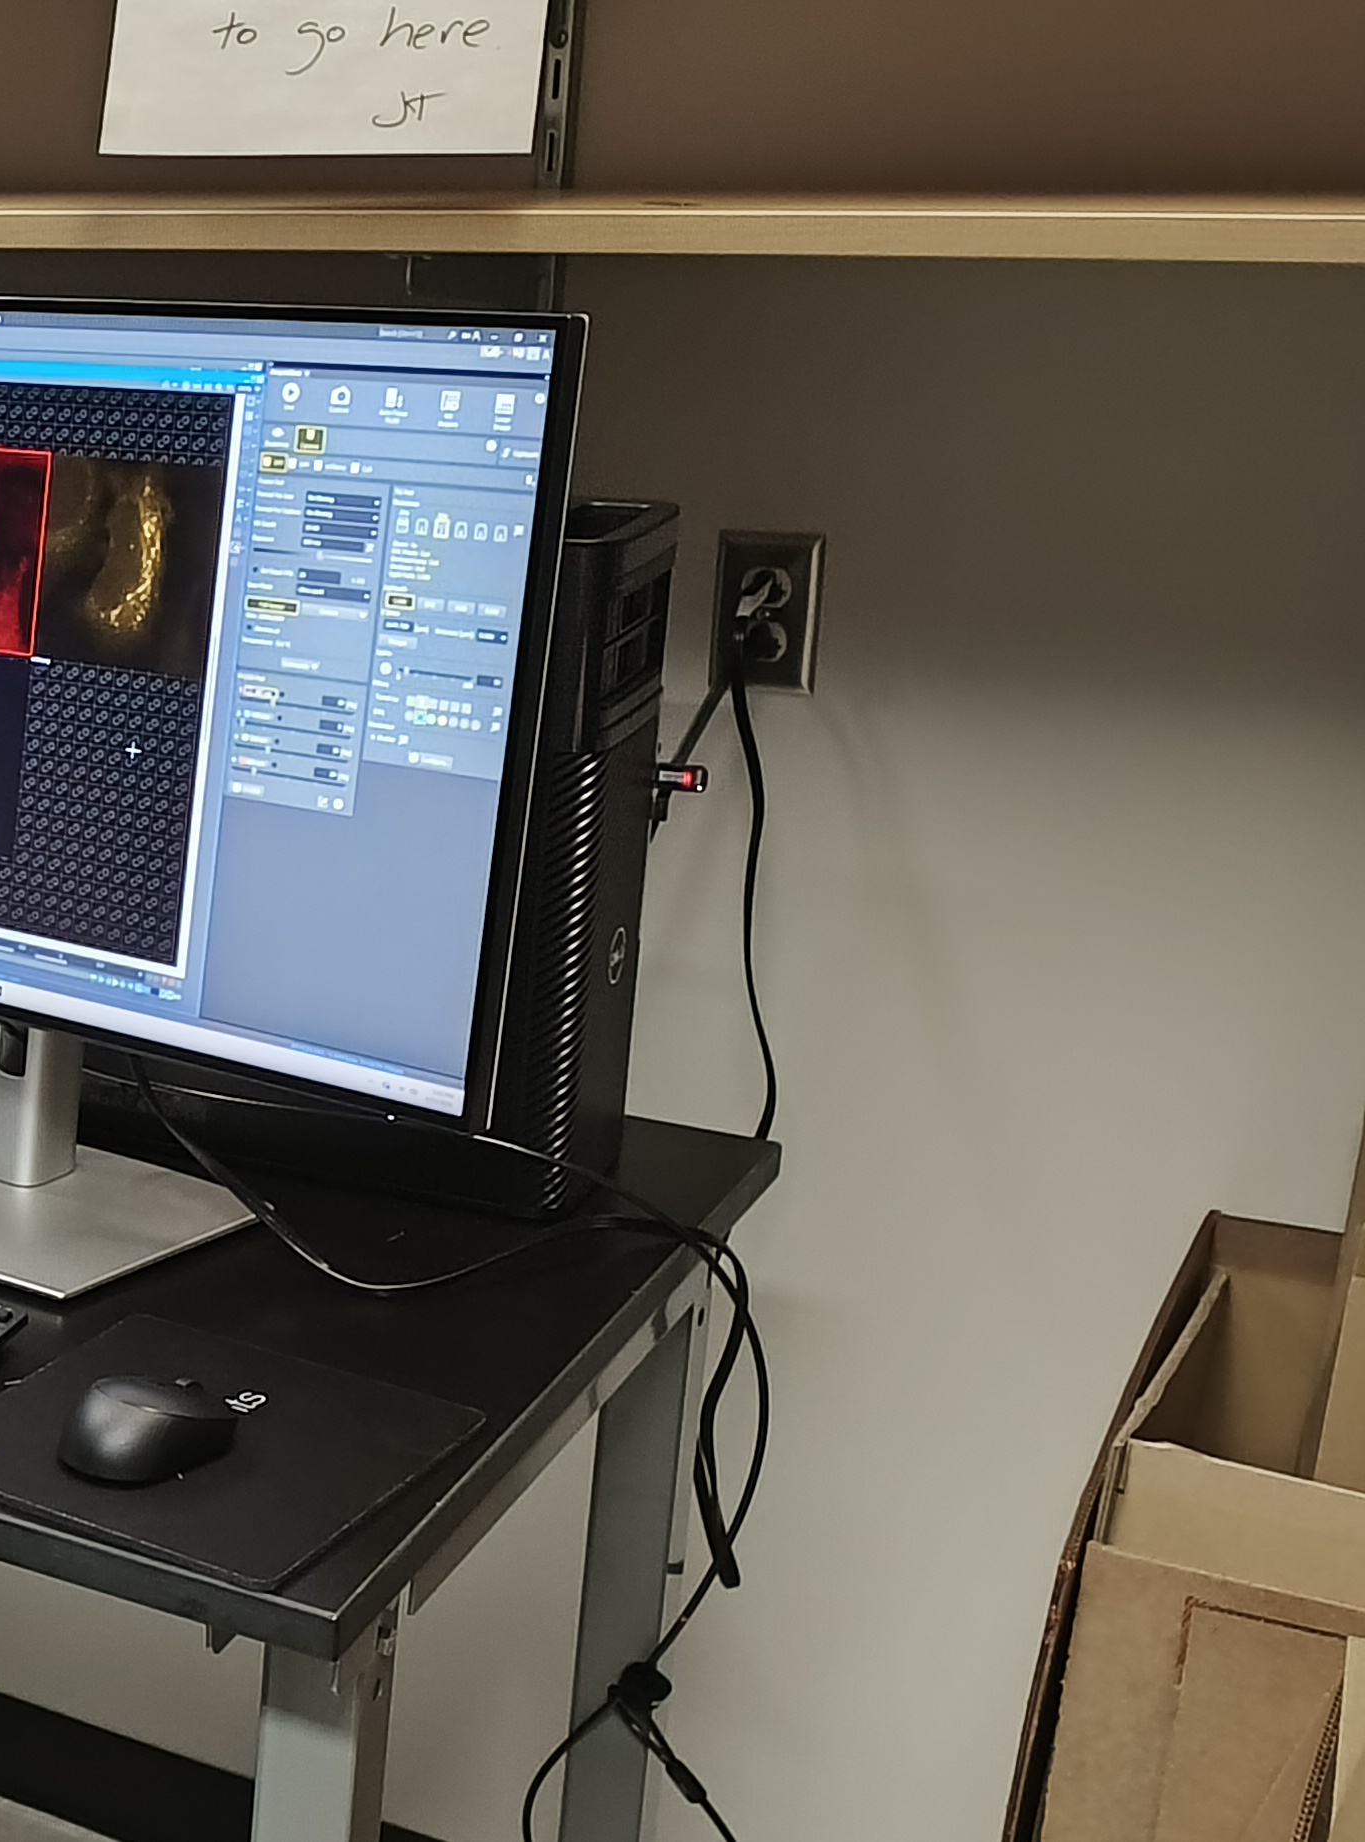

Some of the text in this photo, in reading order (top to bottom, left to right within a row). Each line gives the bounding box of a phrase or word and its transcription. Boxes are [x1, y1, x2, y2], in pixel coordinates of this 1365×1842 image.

[212, 6, 490, 75] to go here
